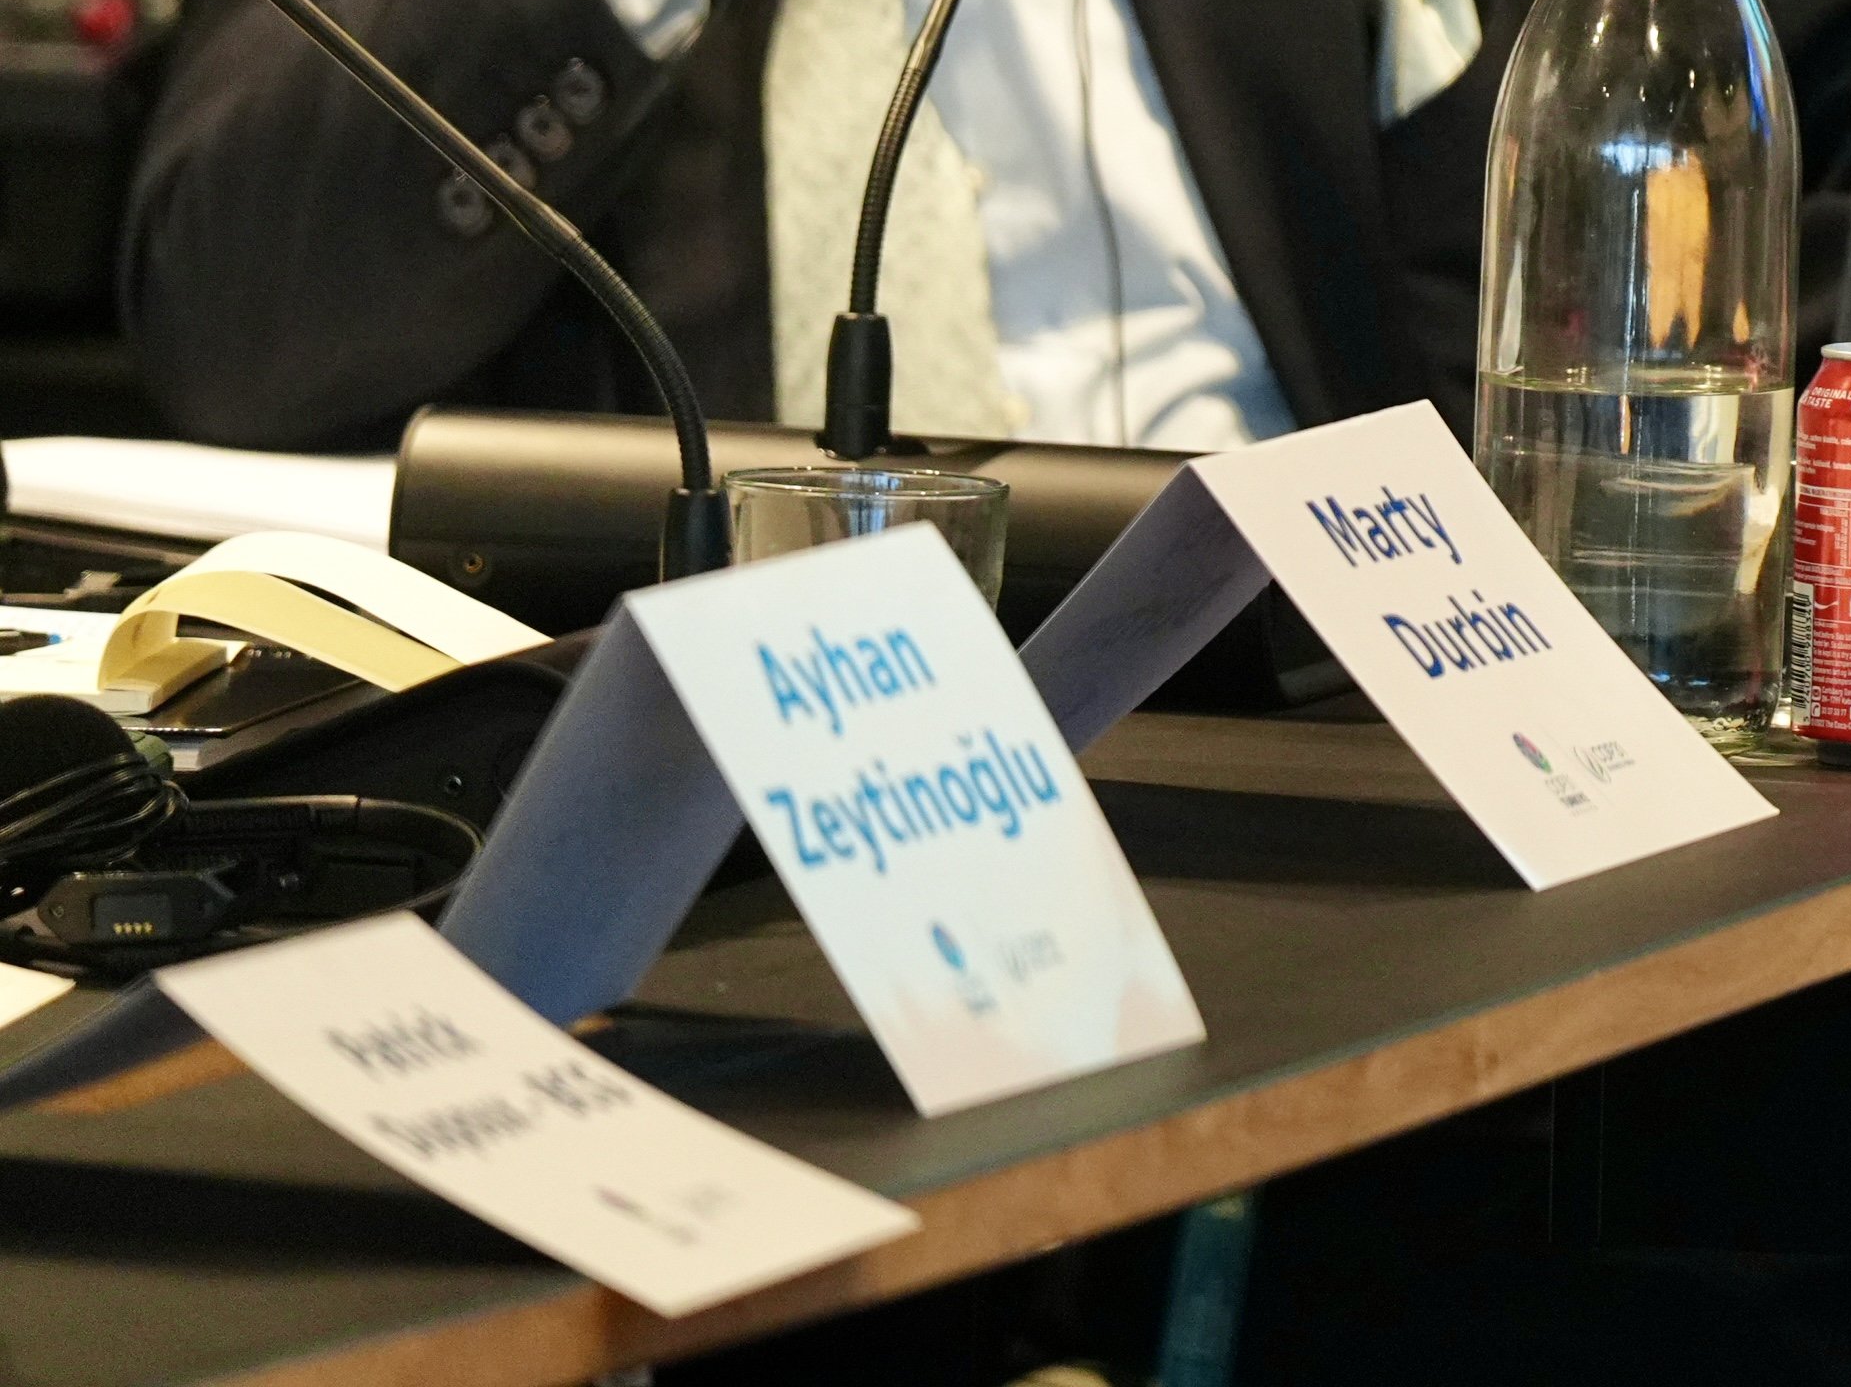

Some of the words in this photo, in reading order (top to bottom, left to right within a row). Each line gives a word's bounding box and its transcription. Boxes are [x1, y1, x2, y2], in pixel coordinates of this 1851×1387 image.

[1806, 396, 1833, 409] TASTE
[1306, 485, 1462, 567] Marty
[1382, 589, 1551, 679] Durbin
[756, 626, 936, 737] Ayhan
[764, 730, 1061, 875] Zeytinoğlu
